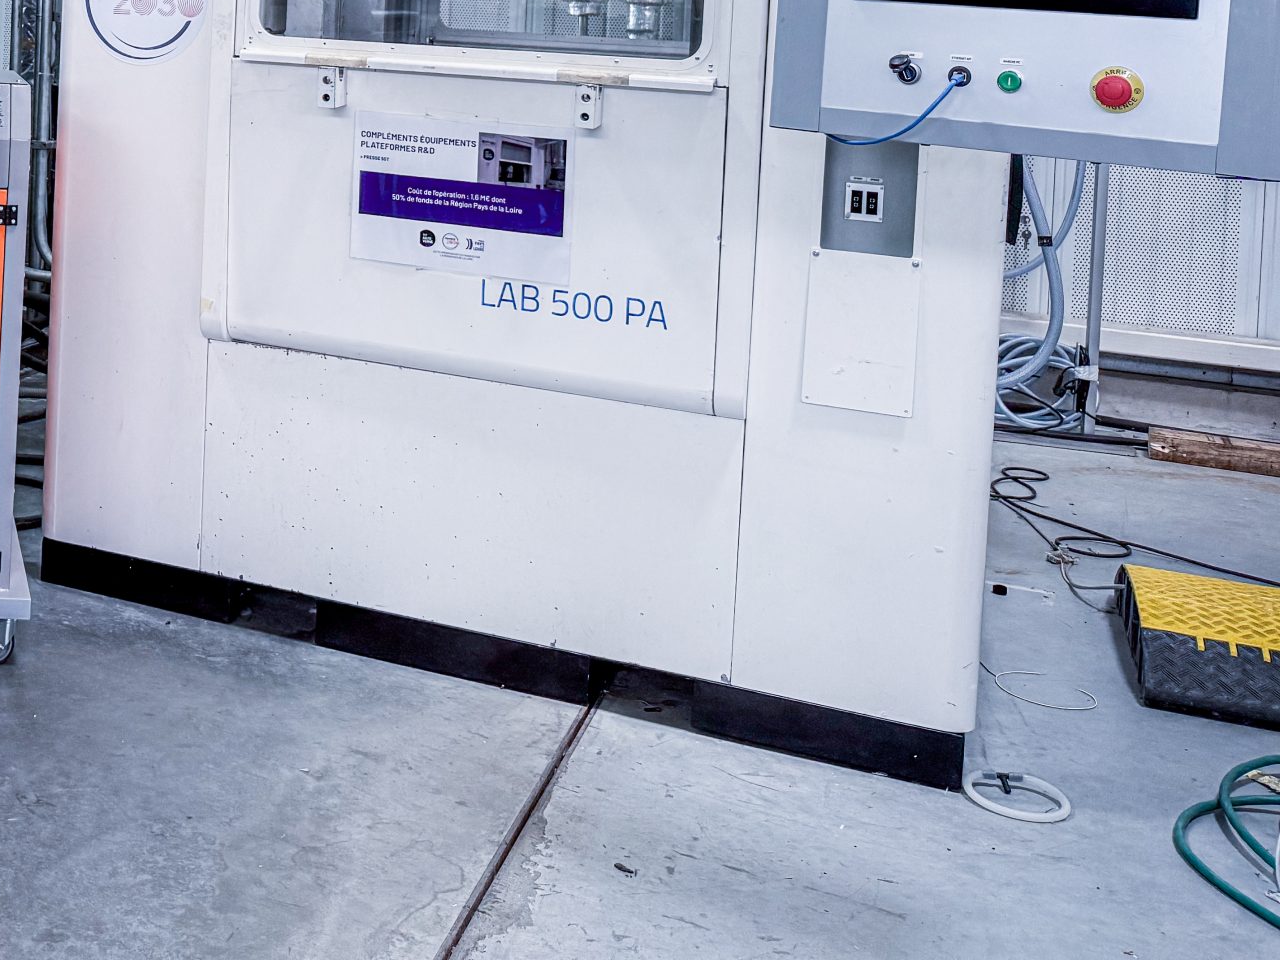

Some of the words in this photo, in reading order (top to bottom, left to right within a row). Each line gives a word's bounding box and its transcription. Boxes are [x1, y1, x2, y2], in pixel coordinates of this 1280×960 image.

[360, 130, 418, 143] COMPLÉMENTS
[420, 134, 477, 148] ÉQUIPEMENTS
[360, 140, 416, 153] PLATEFORMES
[417, 147, 435, 155] R&D
[391, 193, 406, 201] 50%
[415, 196, 433, 204] fonds
[450, 200, 472, 209] Région
[473, 202, 488, 211] Pays
[505, 206, 523, 214] Loire
[491, 196, 506, 204] dont
[481, 278, 540, 312] LAB
[551, 289, 613, 322] 500
[625, 297, 668, 330] PA
